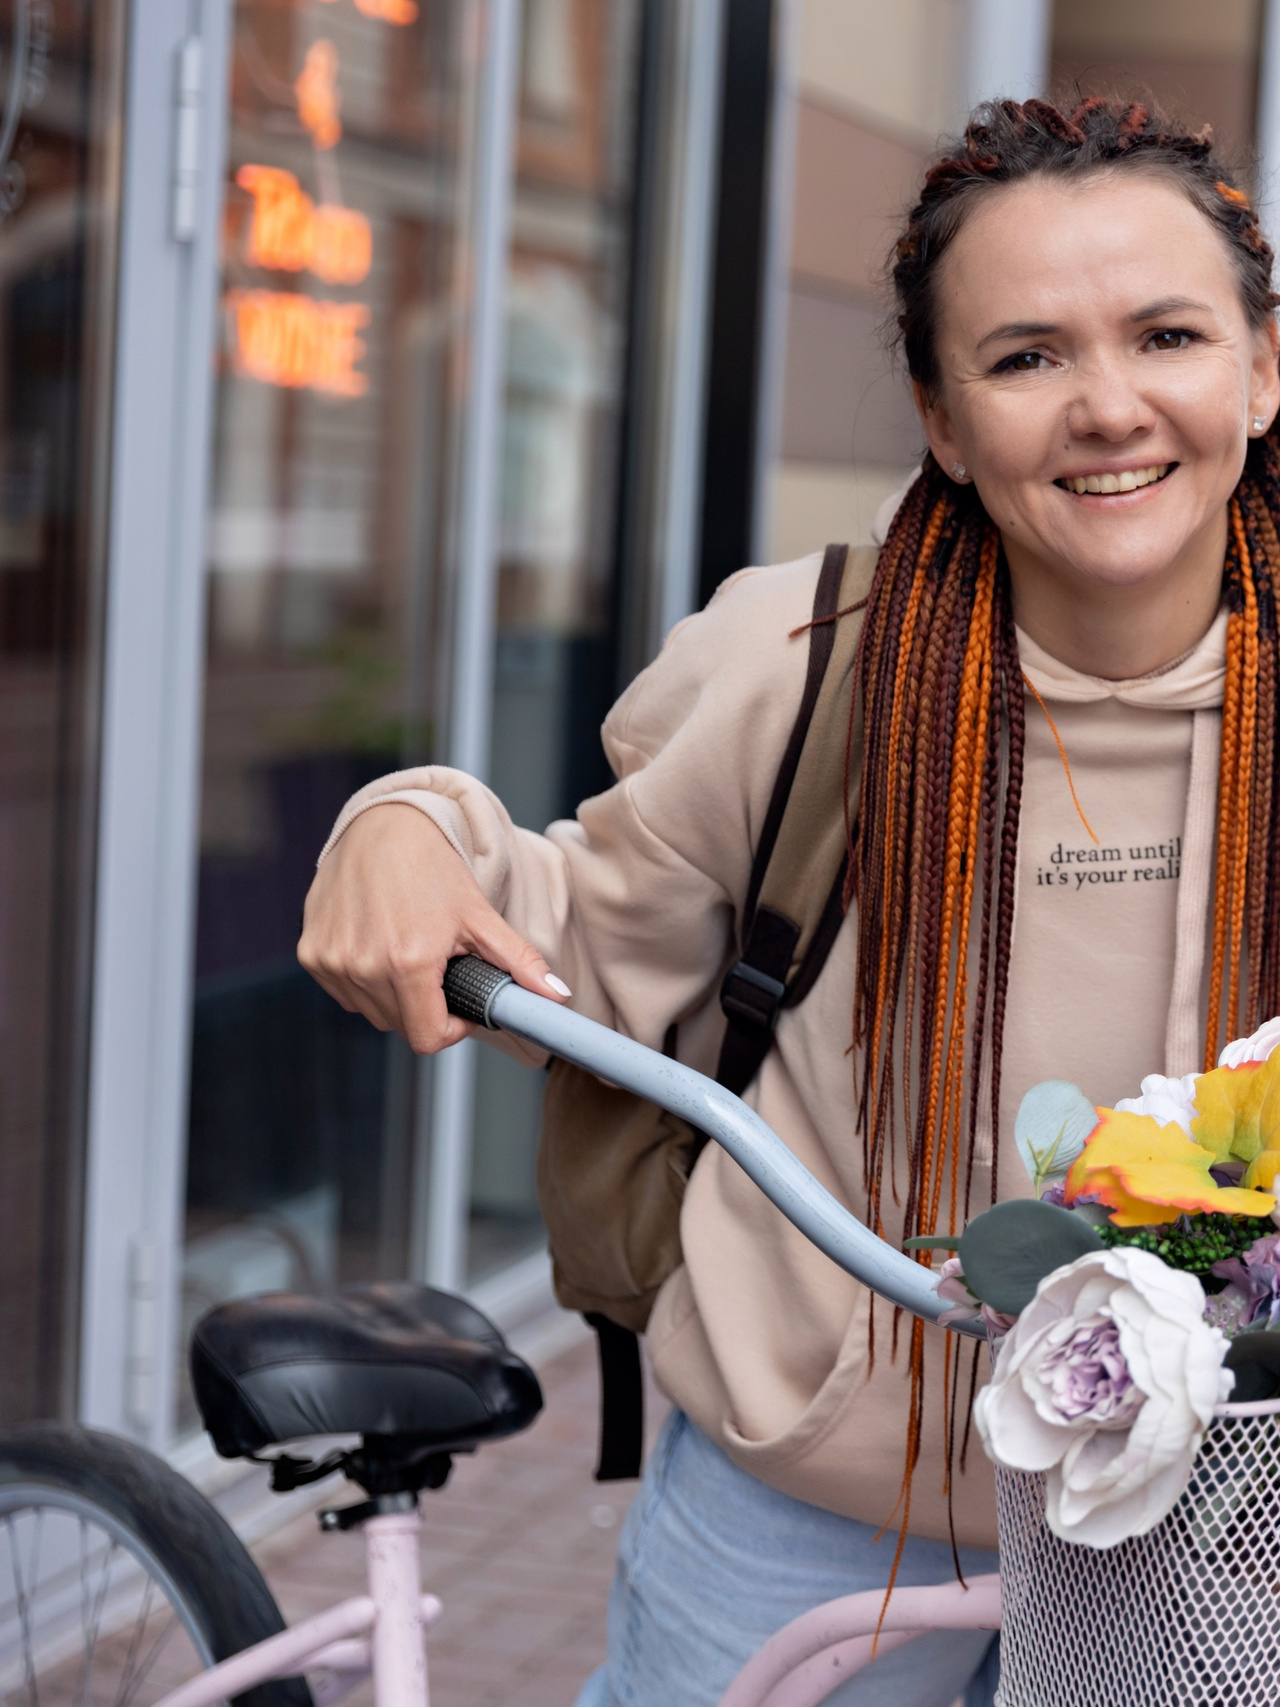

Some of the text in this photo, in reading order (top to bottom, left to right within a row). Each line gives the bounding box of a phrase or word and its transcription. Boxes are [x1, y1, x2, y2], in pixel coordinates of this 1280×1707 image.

[1050, 836, 1181, 864] dream until
[1036, 859, 1180, 891] it's your reali
